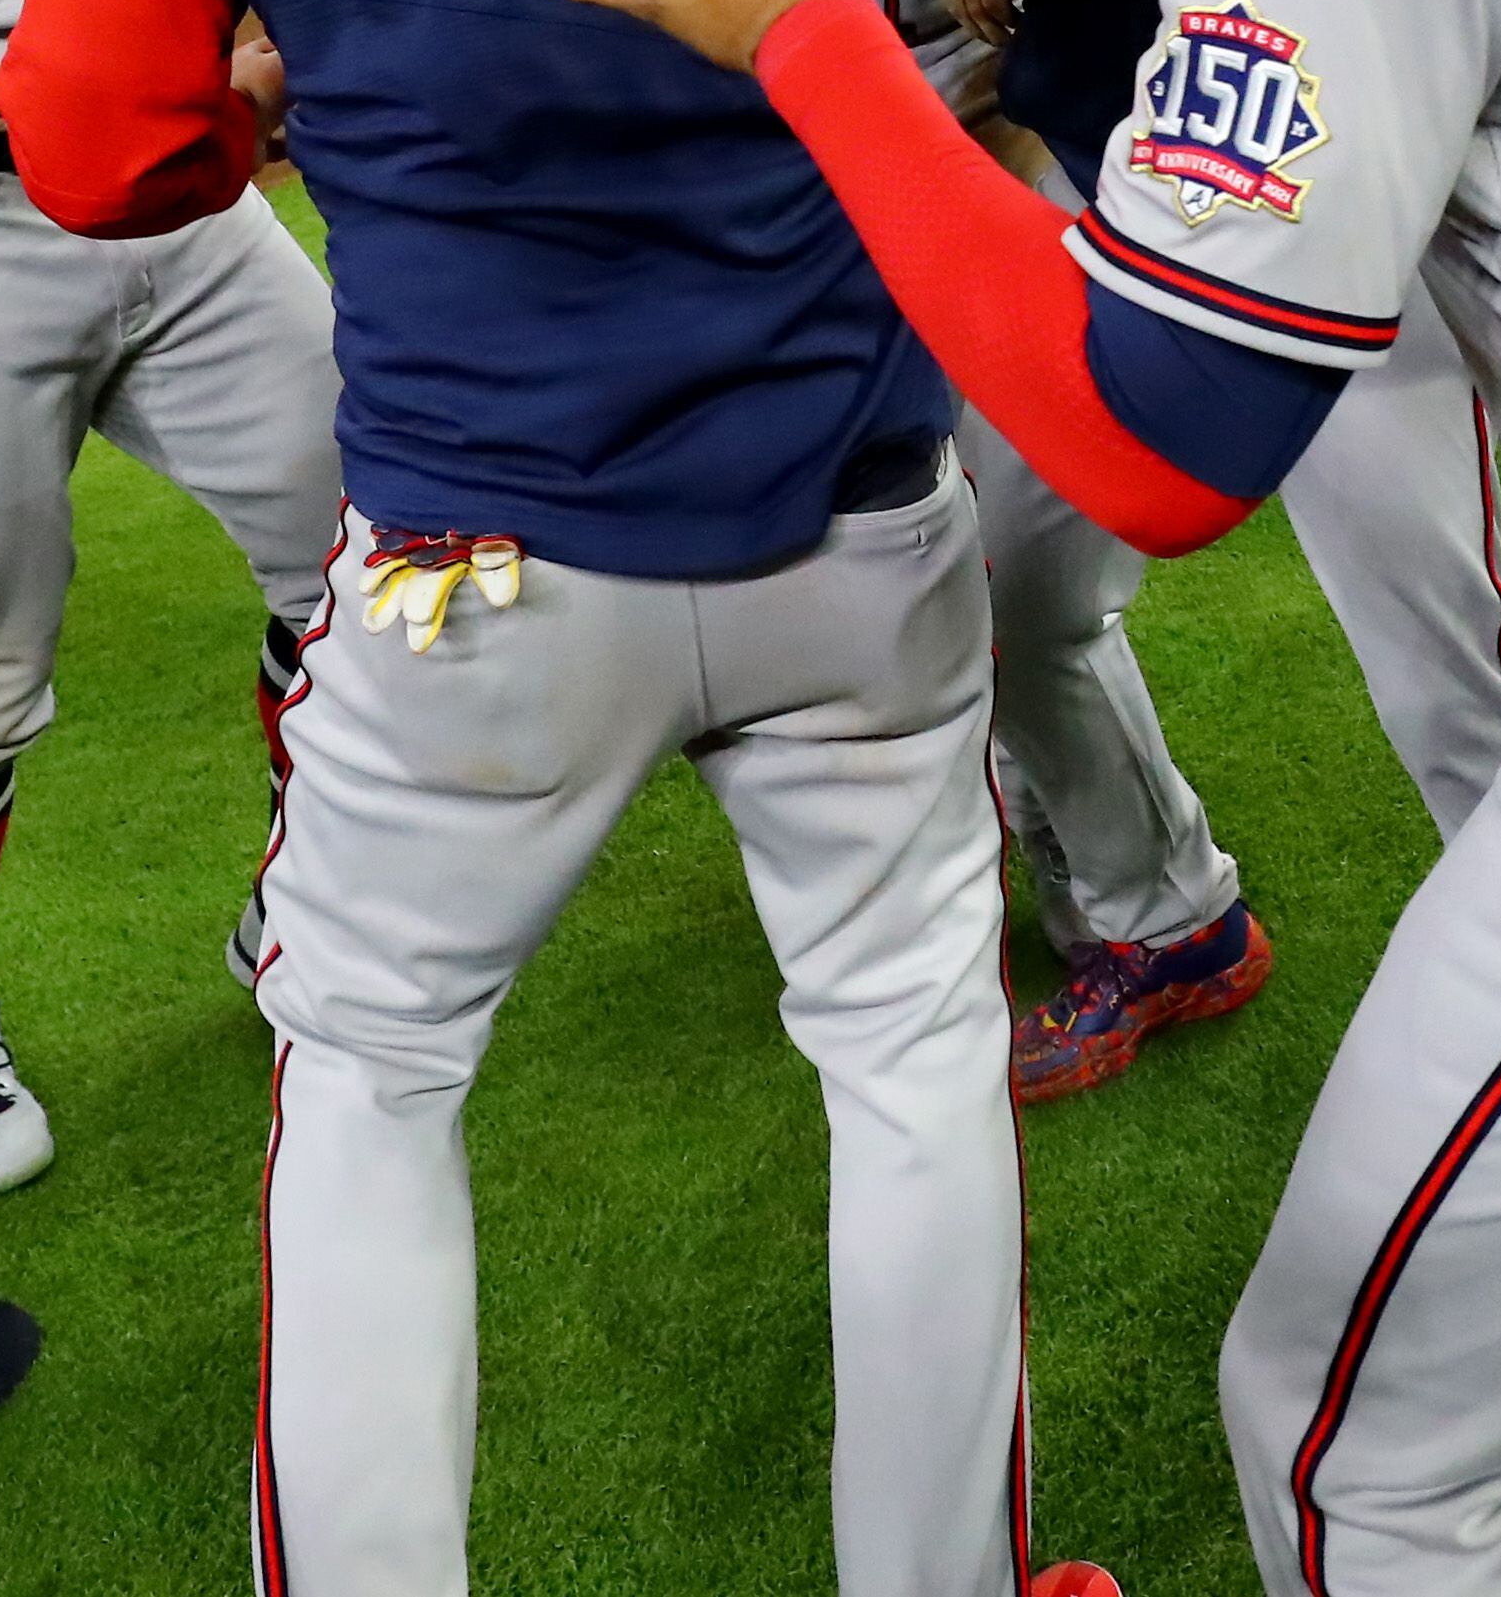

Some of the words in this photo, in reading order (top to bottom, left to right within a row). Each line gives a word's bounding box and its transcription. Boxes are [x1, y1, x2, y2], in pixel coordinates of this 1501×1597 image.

[1188, 15, 1288, 53] BRAVES
[1151, 35, 1301, 165] 150
[1155, 151, 1256, 195] ANNIVERSARY
